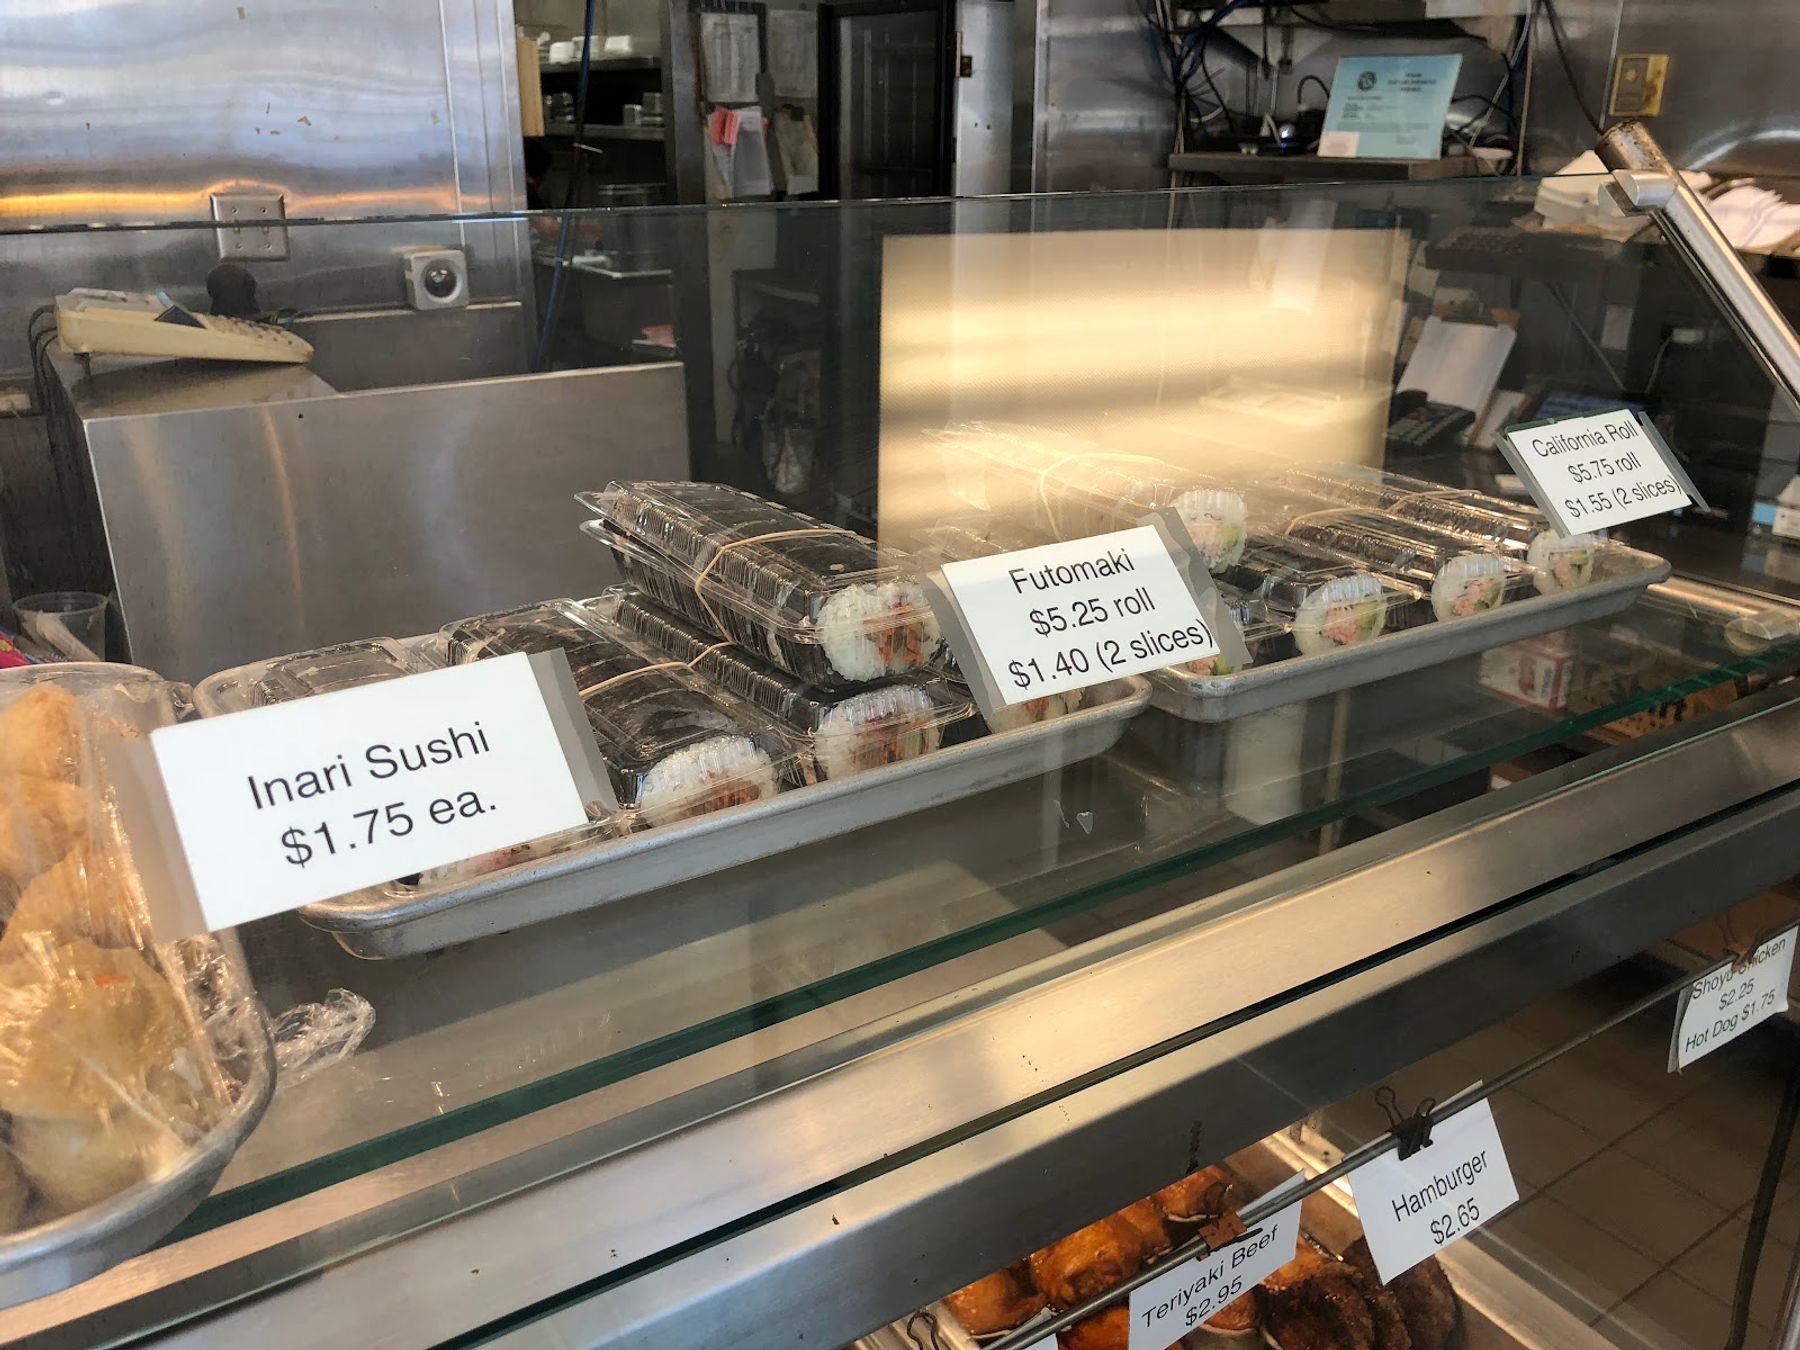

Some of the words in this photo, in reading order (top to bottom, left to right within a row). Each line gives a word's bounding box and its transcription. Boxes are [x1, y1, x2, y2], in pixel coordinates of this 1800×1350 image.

[1532, 429, 1607, 457] California
[1605, 420, 1639, 443] Roll
[1568, 458, 1615, 485] $5.75
[1616, 451, 1642, 473] roll
[1565, 492, 1613, 519] $1.55
[1611, 488, 1632, 510] (2
[1632, 474, 1682, 502] slices)
[1008, 548, 1135, 594] Futomaki
[1029, 598, 1108, 638] $5.25
[1113, 587, 1156, 617] roll
[1008, 648, 1089, 690] $1.40
[1096, 641, 1127, 673] (2
[1129, 618, 1213, 660] slices)
[248, 754, 352, 810] Inari
[365, 721, 490, 779] Sushi
[281, 802, 414, 868] $1.75
[429, 790, 496, 824] ea.
[1685, 1029, 1709, 1053] Hot
[1712, 1014, 1739, 1038] Dog
[1741, 988, 1776, 1022] $1.75
[1719, 978, 1755, 1011] $2.25
[1391, 1150, 1488, 1223] Hamburger
[1430, 1197, 1480, 1246] $2.65
[1141, 1260, 1224, 1328] Teriyaki
[1231, 1223, 1278, 1269] Beef
[1185, 1275, 1242, 1328] $2.95
